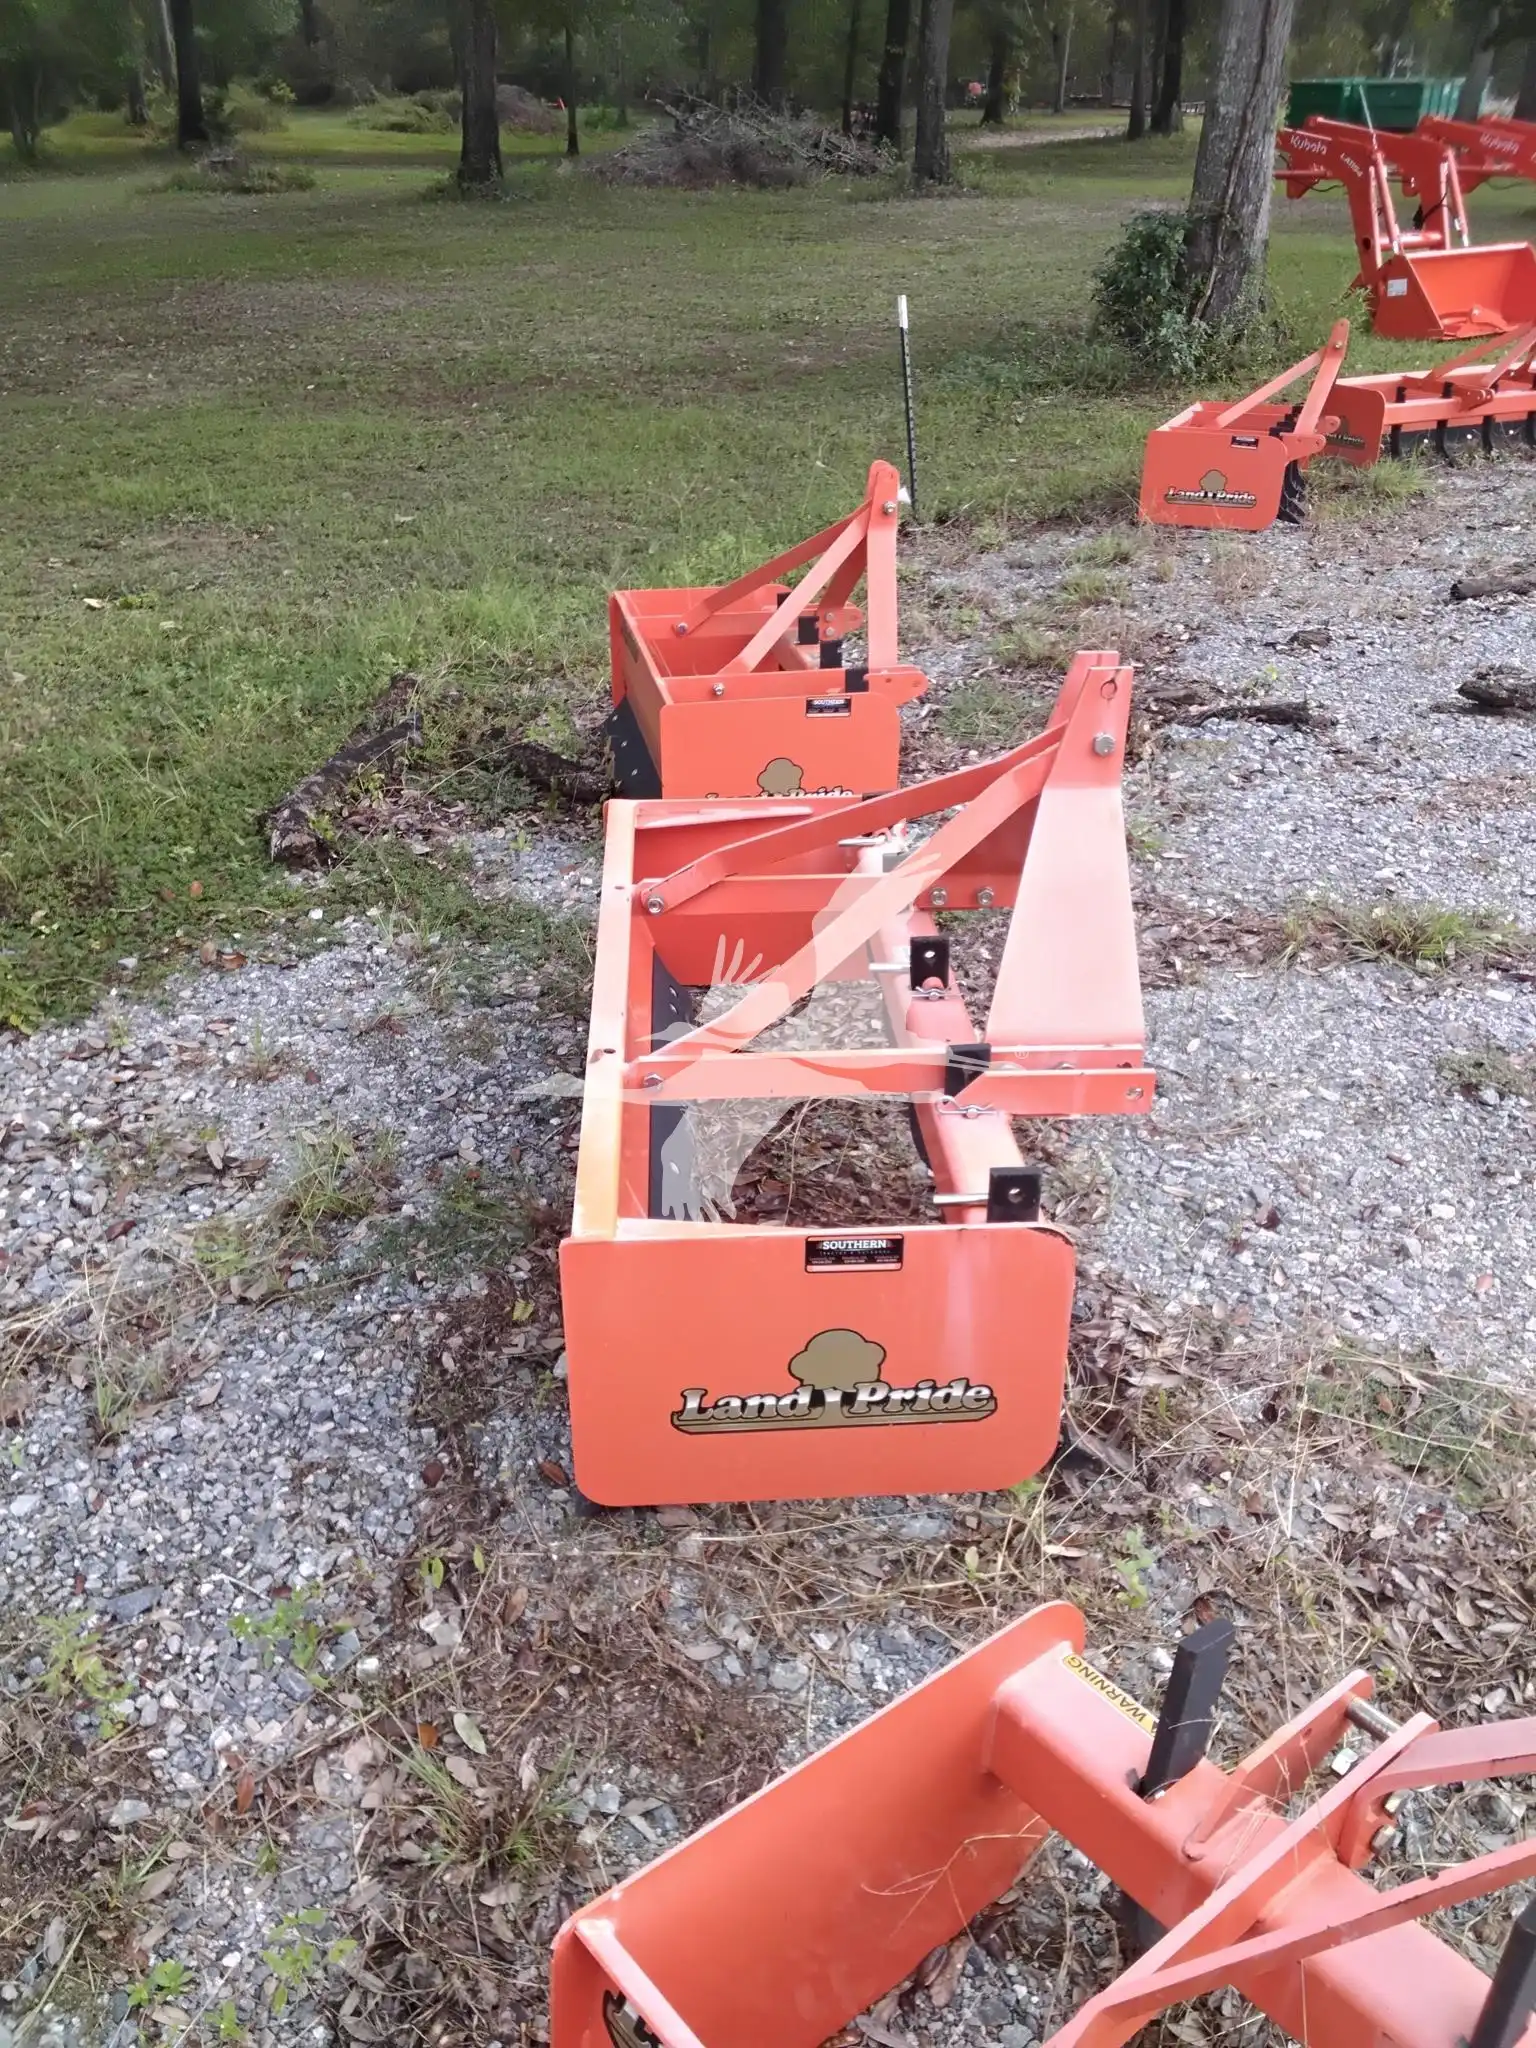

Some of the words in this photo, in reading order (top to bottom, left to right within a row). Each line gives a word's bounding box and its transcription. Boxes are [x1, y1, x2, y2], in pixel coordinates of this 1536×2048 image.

[1290, 134, 1328, 156] Kubota
[1168, 485, 1206, 502] Land
[1216, 489, 1257, 505] Pride
[822, 1239, 887, 1250] SOUTHERN
[677, 1384, 815, 1421] Land
[848, 1377, 995, 1414] Pride
[1066, 1656, 1147, 1722] WARNING
